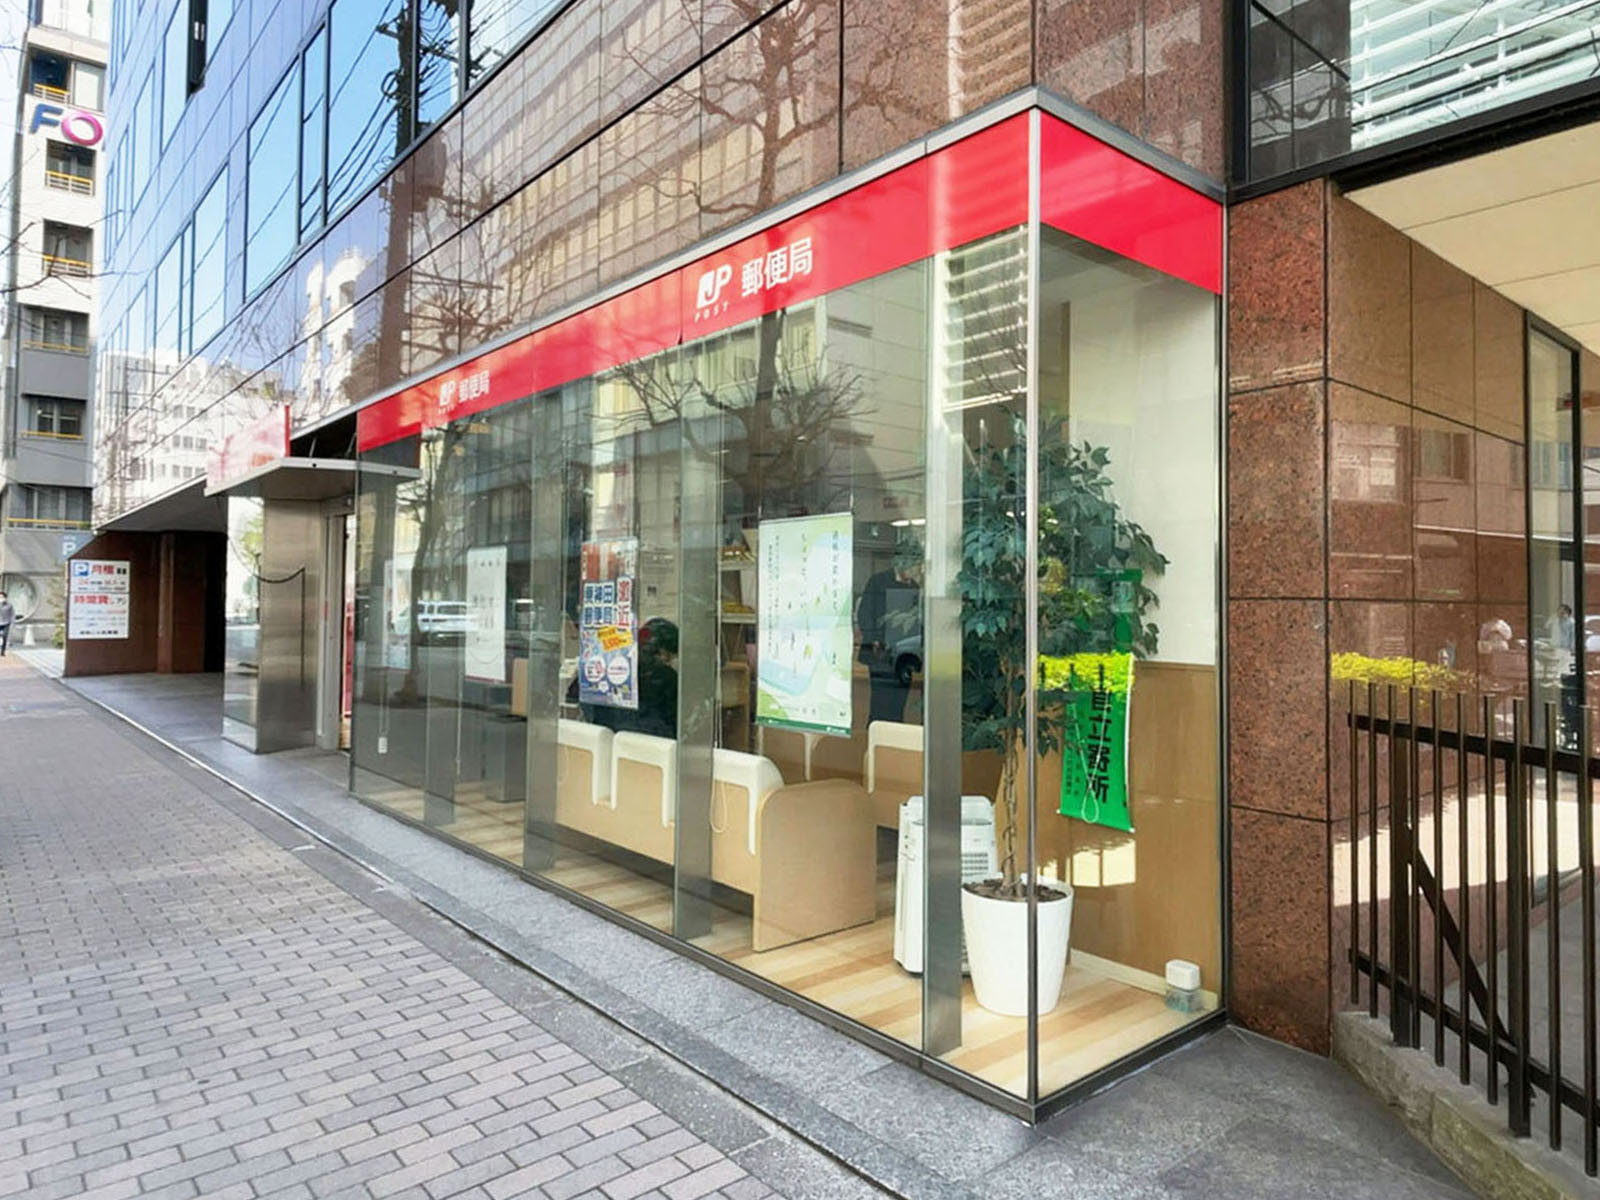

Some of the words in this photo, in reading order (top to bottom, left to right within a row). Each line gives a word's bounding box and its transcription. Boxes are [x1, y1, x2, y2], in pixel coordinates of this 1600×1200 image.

[696, 264, 732, 309] JP
[741, 237, 812, 297] 郵便局
[694, 301, 729, 323] POST
[459, 370, 490, 404] 郵便局
